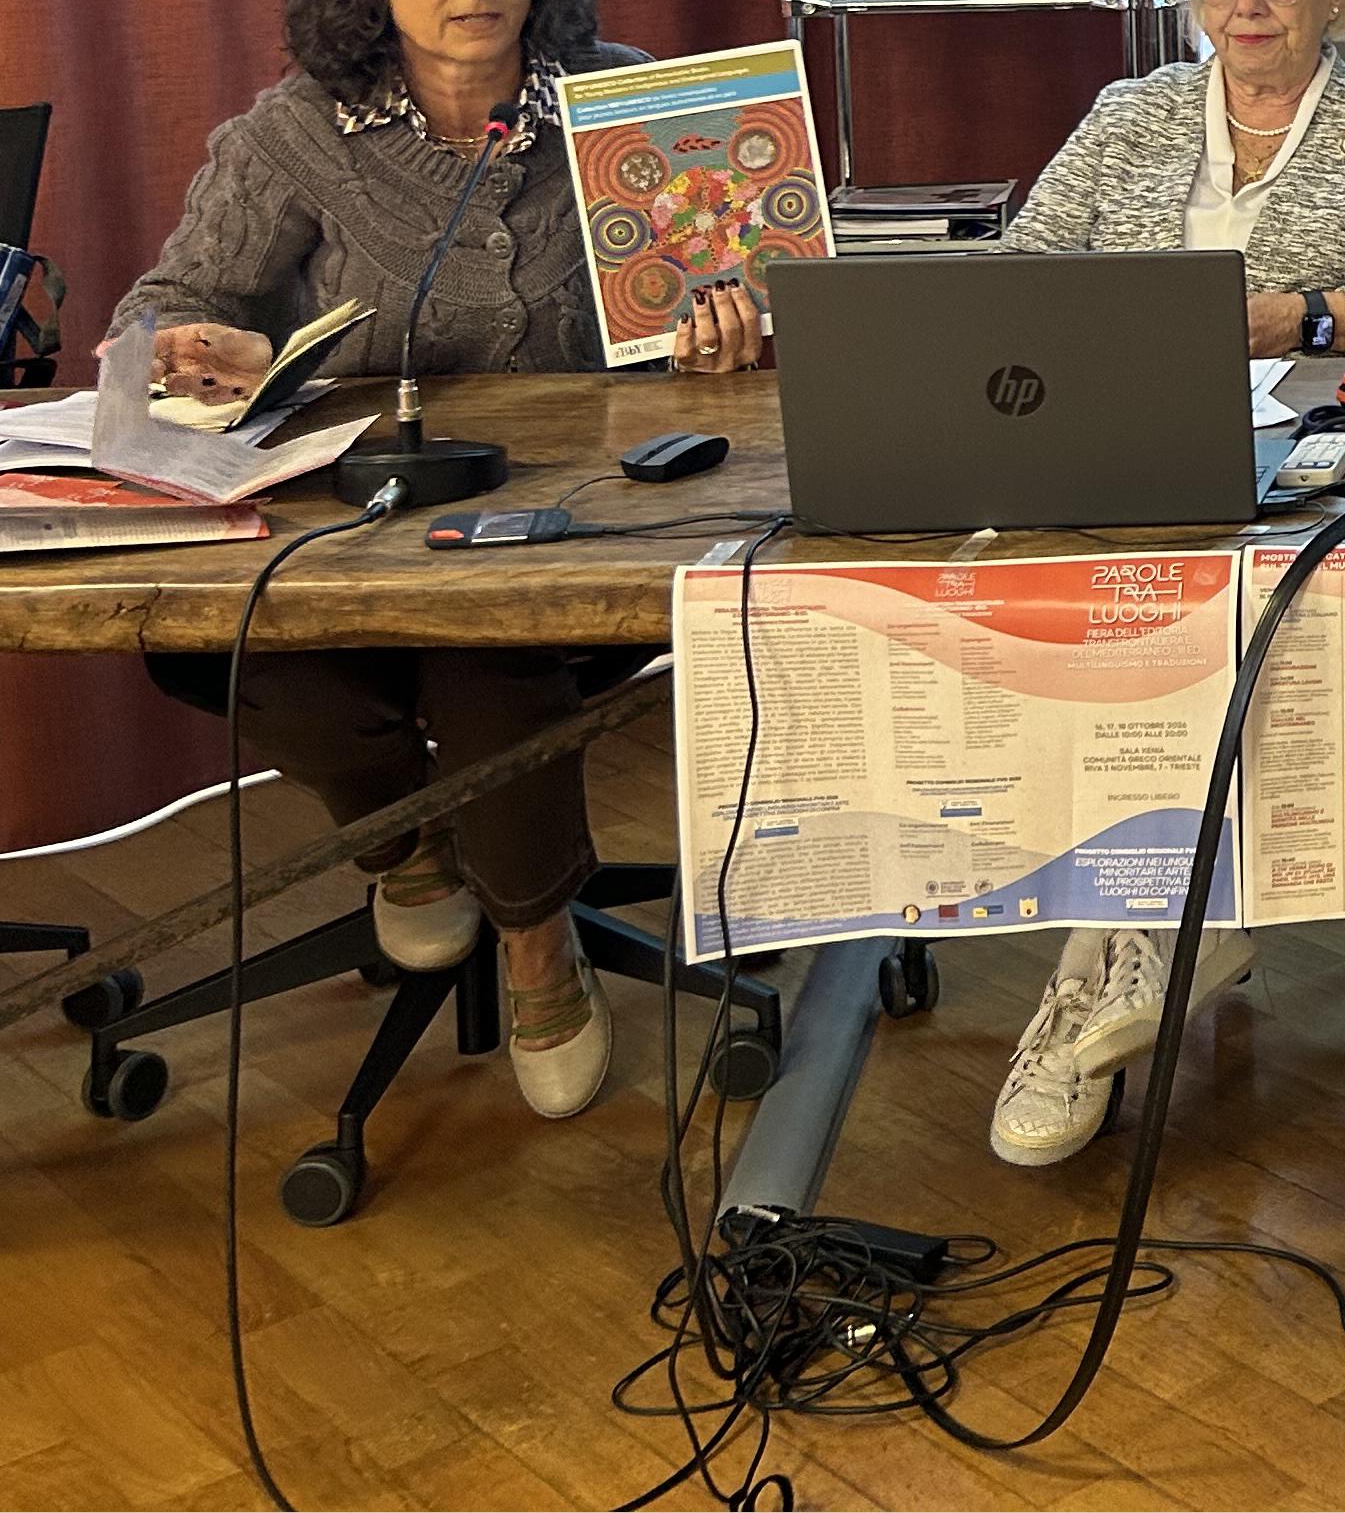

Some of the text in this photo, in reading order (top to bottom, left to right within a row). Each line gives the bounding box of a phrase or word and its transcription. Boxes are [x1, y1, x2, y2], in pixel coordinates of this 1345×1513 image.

[994, 365, 1040, 417] hp
[1261, 554, 1297, 562] MOSTR
[1091, 562, 1185, 584] PAROLE
[1088, 601, 1182, 625] LUOGHI
